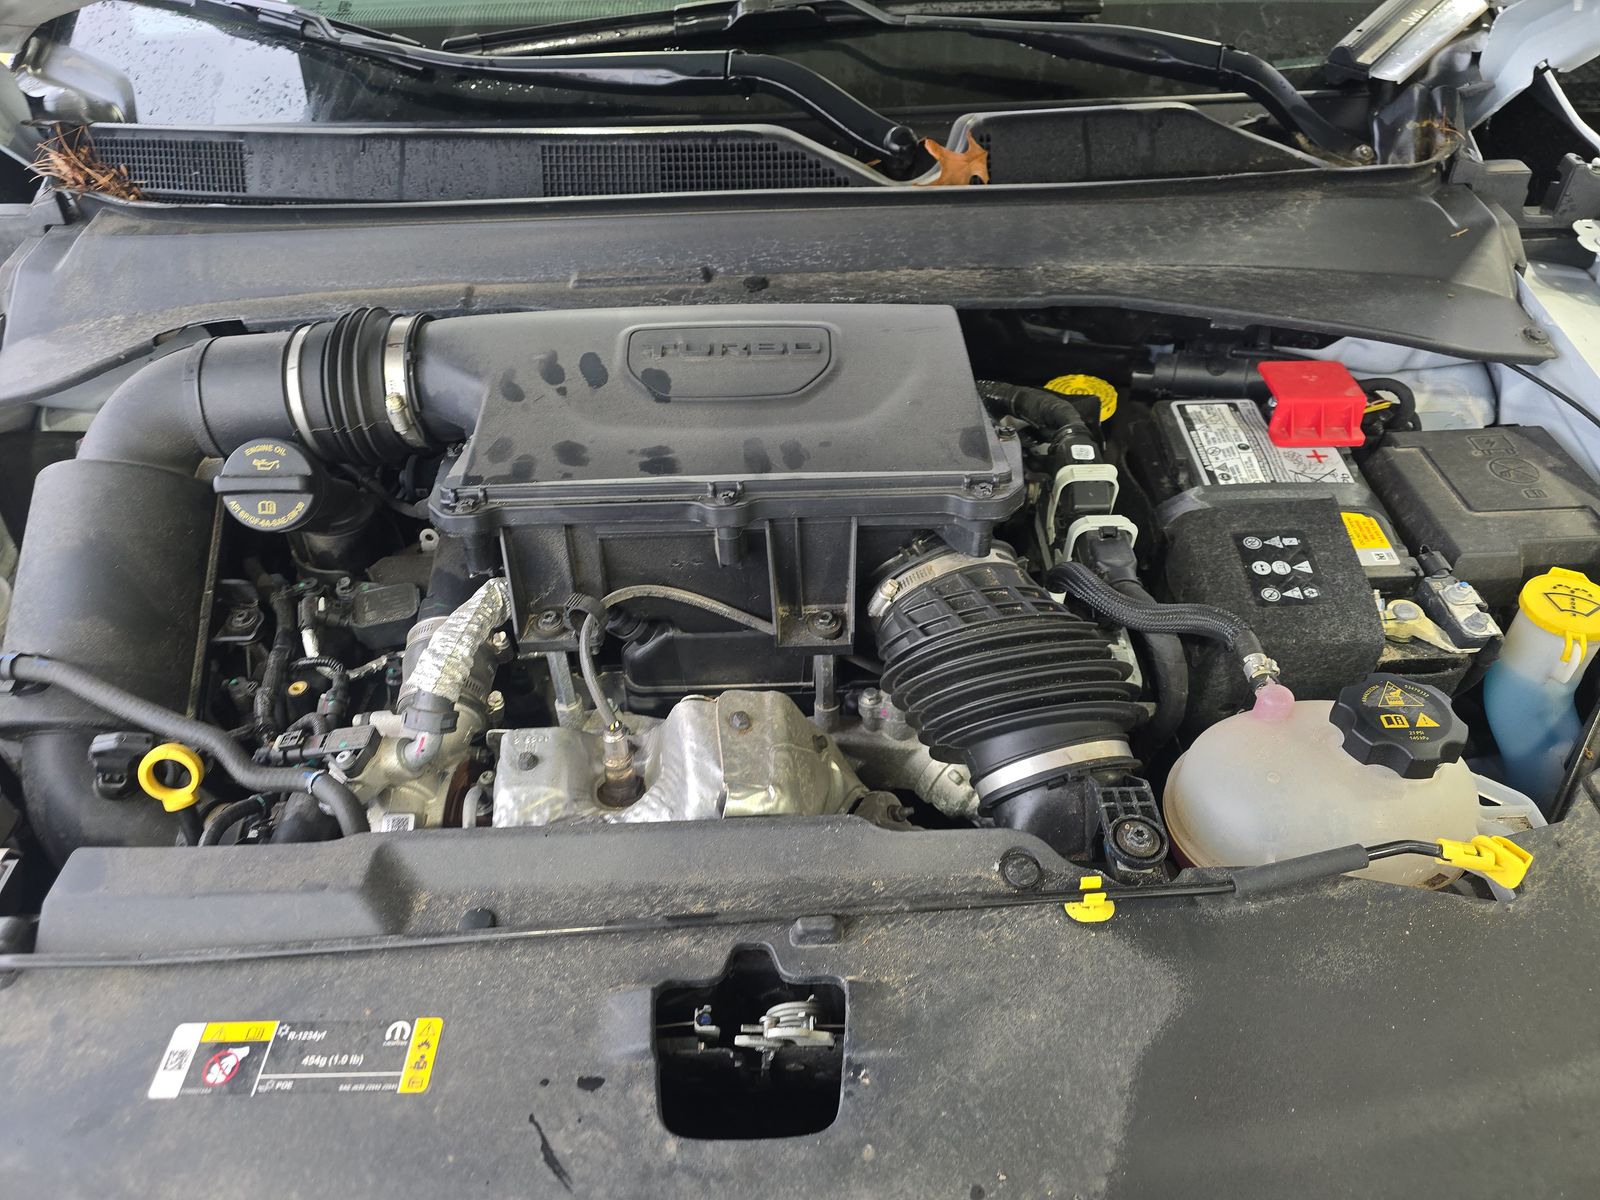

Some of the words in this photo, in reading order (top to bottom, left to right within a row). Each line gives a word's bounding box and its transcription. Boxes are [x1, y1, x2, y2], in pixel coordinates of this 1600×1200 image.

[641, 341, 823, 359] TURBO
[244, 444, 274, 457] ENGINE
[274, 445, 287, 457] OIL
[228, 500, 241, 514] API
[287, 1030, 328, 1042] R-1234yf
[301, 1054, 328, 1068] 454g
[349, 1053, 364, 1067] lb)
